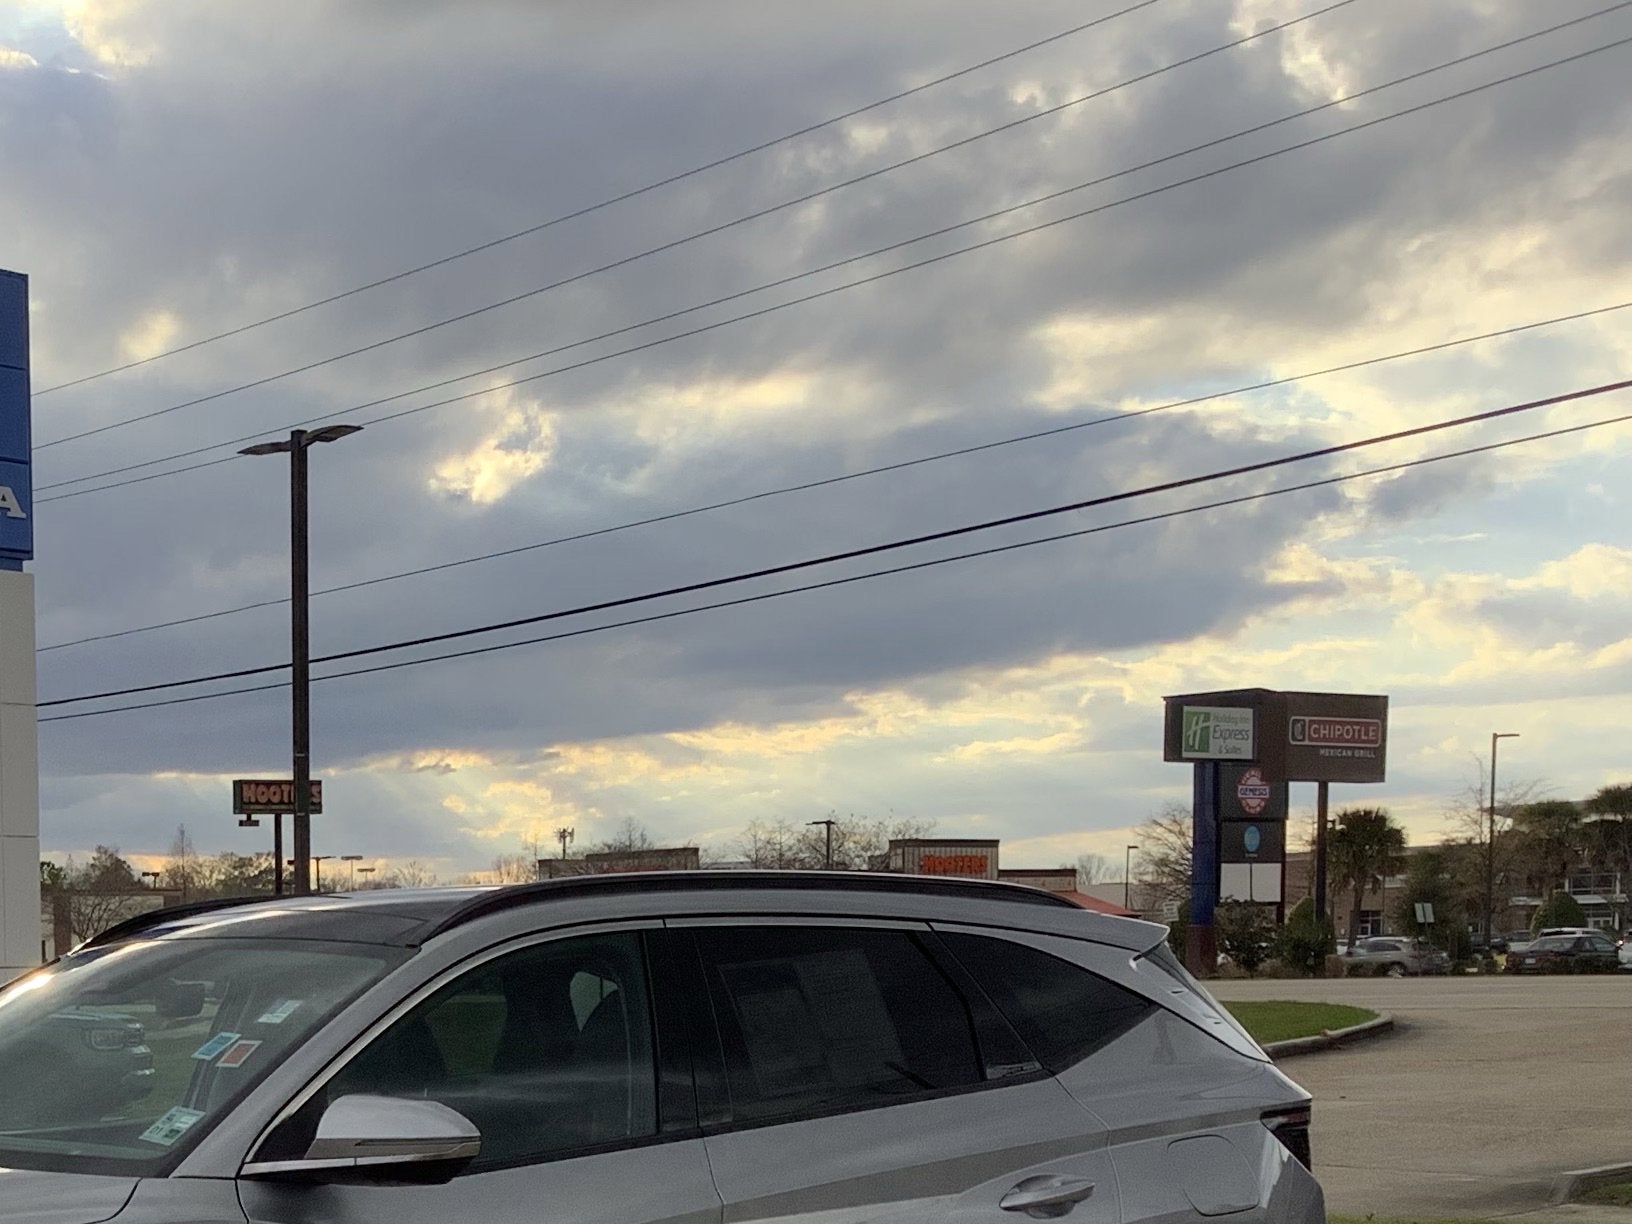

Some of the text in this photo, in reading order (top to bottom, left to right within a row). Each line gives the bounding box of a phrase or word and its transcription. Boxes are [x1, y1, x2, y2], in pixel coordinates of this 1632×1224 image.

[1212, 724, 1250, 743] Express
[1309, 724, 1377, 740] CHIPOTLE
[1319, 748, 1375, 758] MEXICAN GRILL
[242, 783, 321, 803] HOOTS
[1239, 787, 1267, 796] GENESIS
